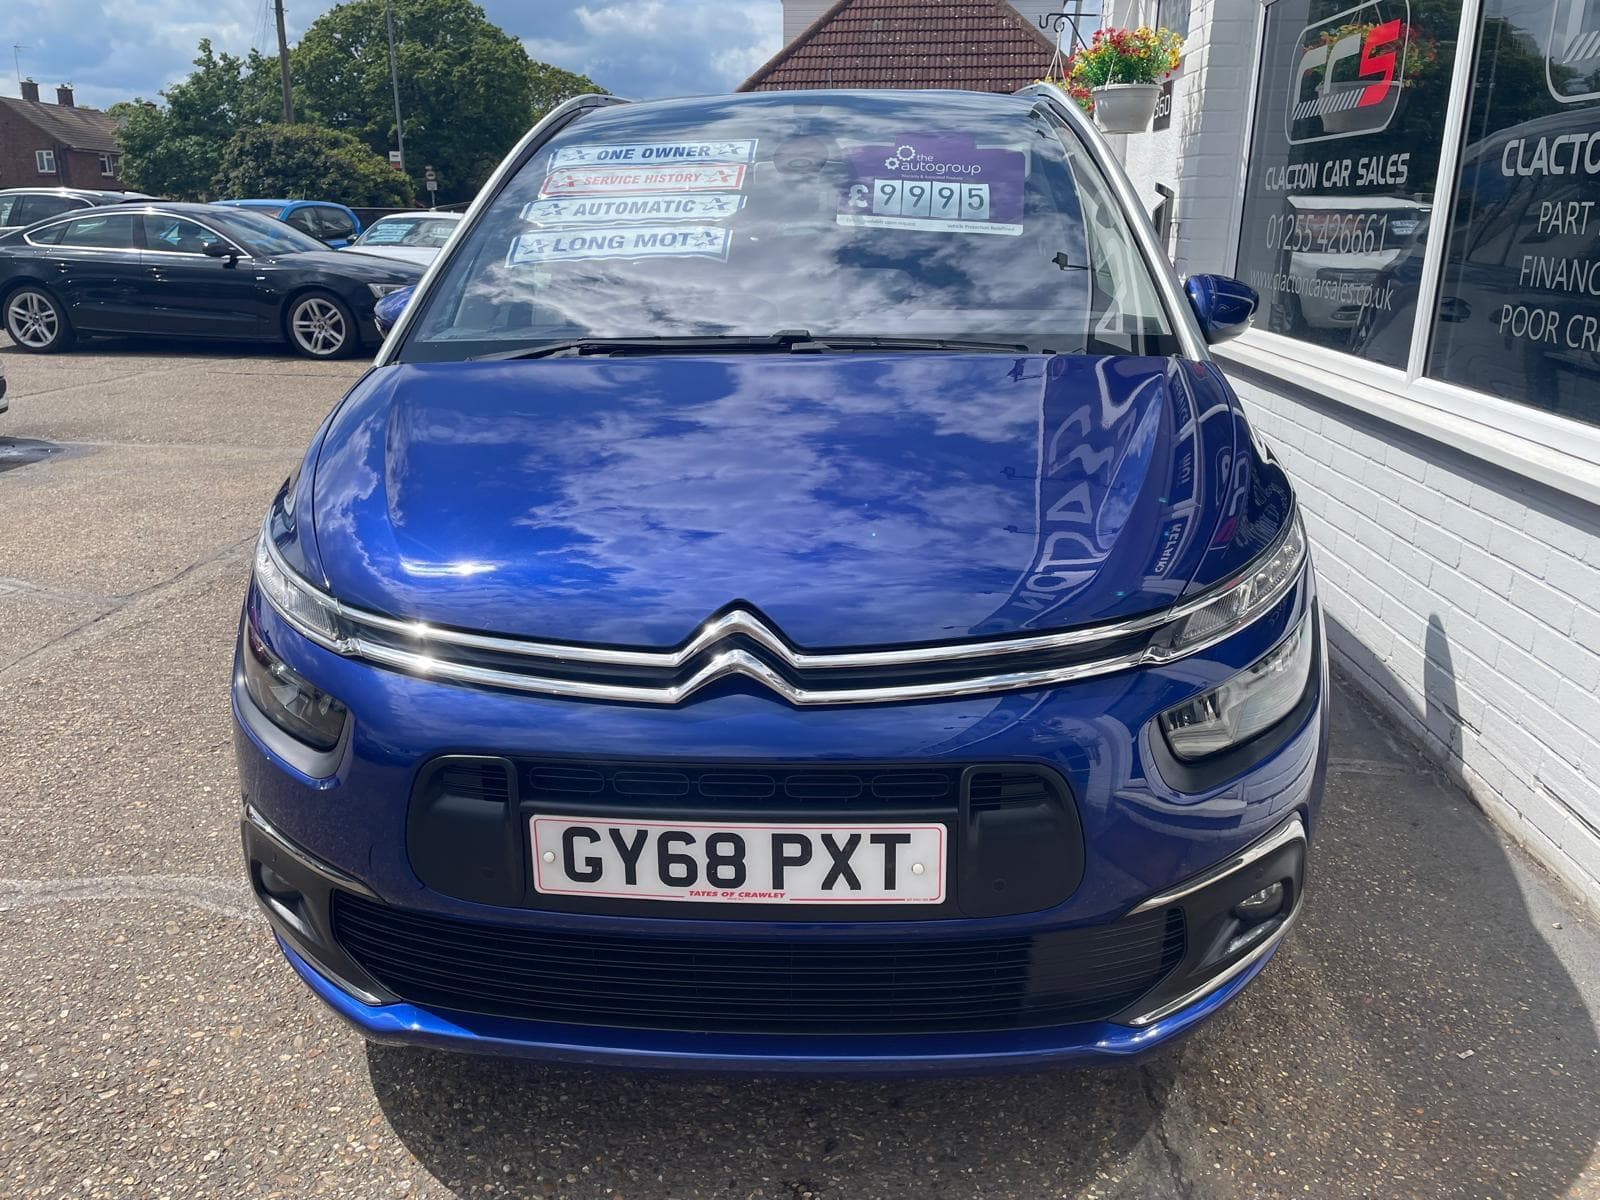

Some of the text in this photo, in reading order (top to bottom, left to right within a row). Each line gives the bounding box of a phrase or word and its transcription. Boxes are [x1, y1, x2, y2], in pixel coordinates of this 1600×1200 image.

[597, 146, 710, 161] ONE OWNER
[917, 153, 934, 162] the
[901, 161, 981, 175] autogroup
[1265, 153, 1410, 190] CLACTON CAR SALES
[583, 173, 702, 186] SERVICE HISTORY
[573, 199, 696, 216] AUTOMATIC
[1537, 201, 1595, 235] PART
[552, 232, 695, 252] LONG MOT
[1266, 213, 1389, 257] 01255 426661
[1498, 304, 1600, 353] POOR CR
[562, 826, 911, 891] GY68 PXT
